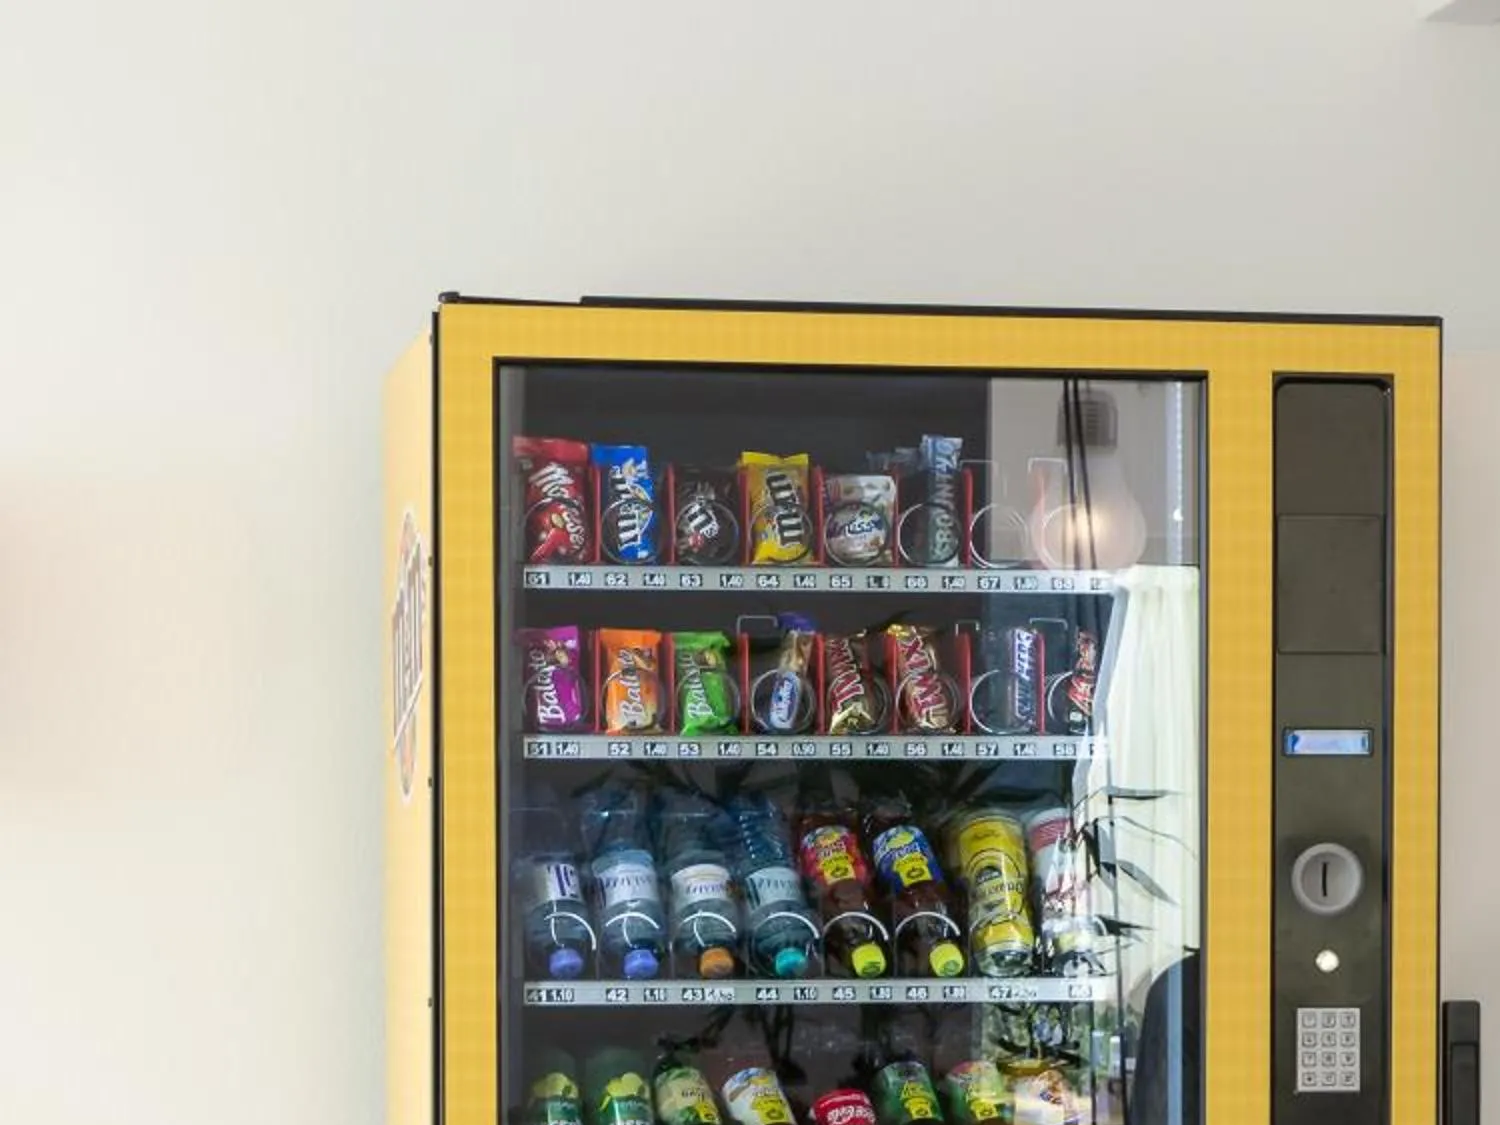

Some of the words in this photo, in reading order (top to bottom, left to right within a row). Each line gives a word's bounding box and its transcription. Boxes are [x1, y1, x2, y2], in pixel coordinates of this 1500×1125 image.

[606, 573, 627, 586] 62
[757, 574, 778, 587] 64
[979, 576, 1000, 589] 67
[610, 743, 631, 756] 52
[756, 742, 778, 755] 54
[606, 988, 627, 1001] 42
[683, 988, 704, 1001] 43
[757, 987, 778, 1000] 44
